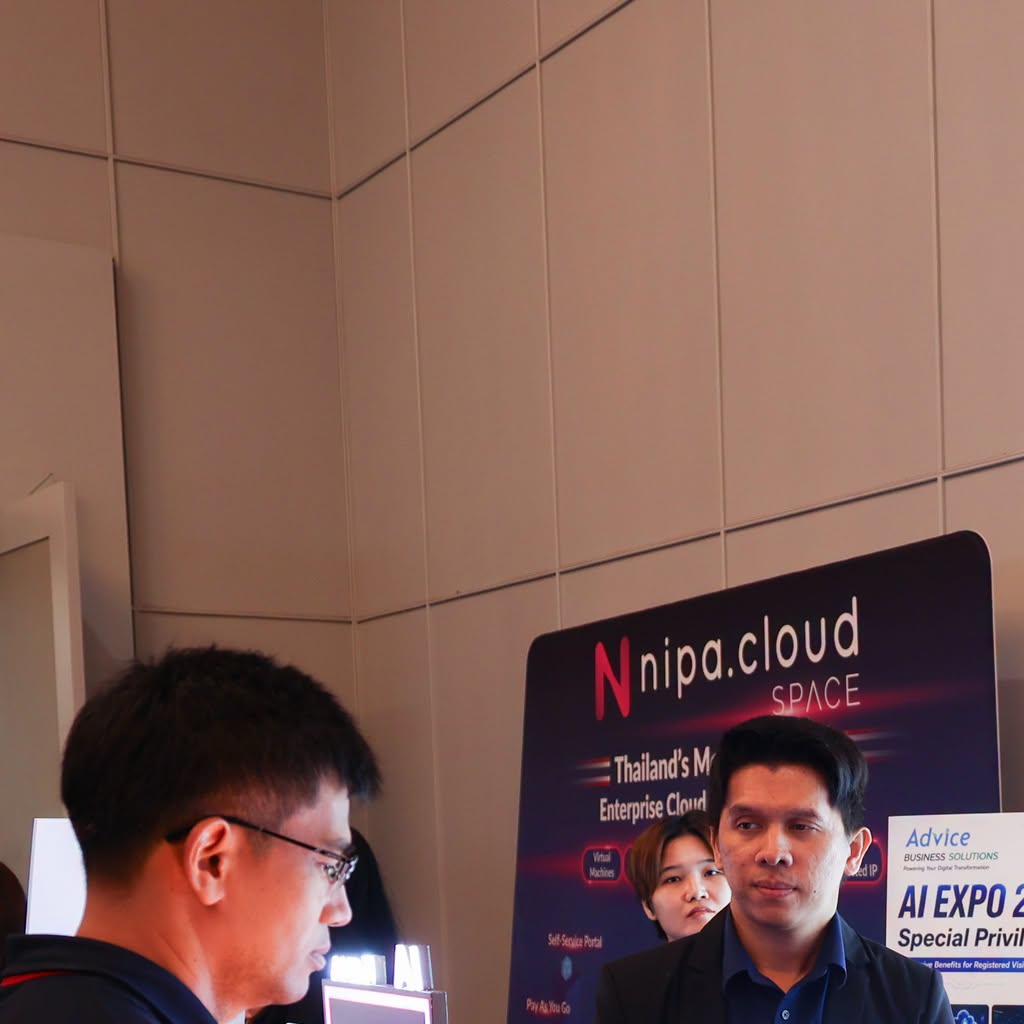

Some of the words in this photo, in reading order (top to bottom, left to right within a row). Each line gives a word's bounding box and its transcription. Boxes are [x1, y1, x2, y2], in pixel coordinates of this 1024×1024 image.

[641, 596, 859, 699] nipa.cloud
[772, 673, 861, 715] SPACE
[614, 748, 689, 784] Thailand's
[600, 796, 663, 823] Enterprise
[666, 790, 706, 816] Cloud
[906, 827, 970, 847] Advice
[593, 851, 611, 863] Virtual
[904, 853, 946, 862] BUSINESS
[948, 852, 998, 861] SOLUTIONS
[589, 866, 615, 878] Machines
[869, 863, 878, 877] IP
[898, 885, 928, 918] AI
[934, 884, 1007, 918] EXPO
[548, 934, 583, 949] Self-Service
[584, 935, 603, 949] Portal
[898, 928, 969, 951] Special
[934, 961, 961, 969] Benefits
[963, 961, 973, 969] for
[974, 961, 1011, 970] Registered
[526, 998, 538, 1013] Pay
[549, 1001, 561, 1014] You
[561, 1003, 571, 1015] Go
